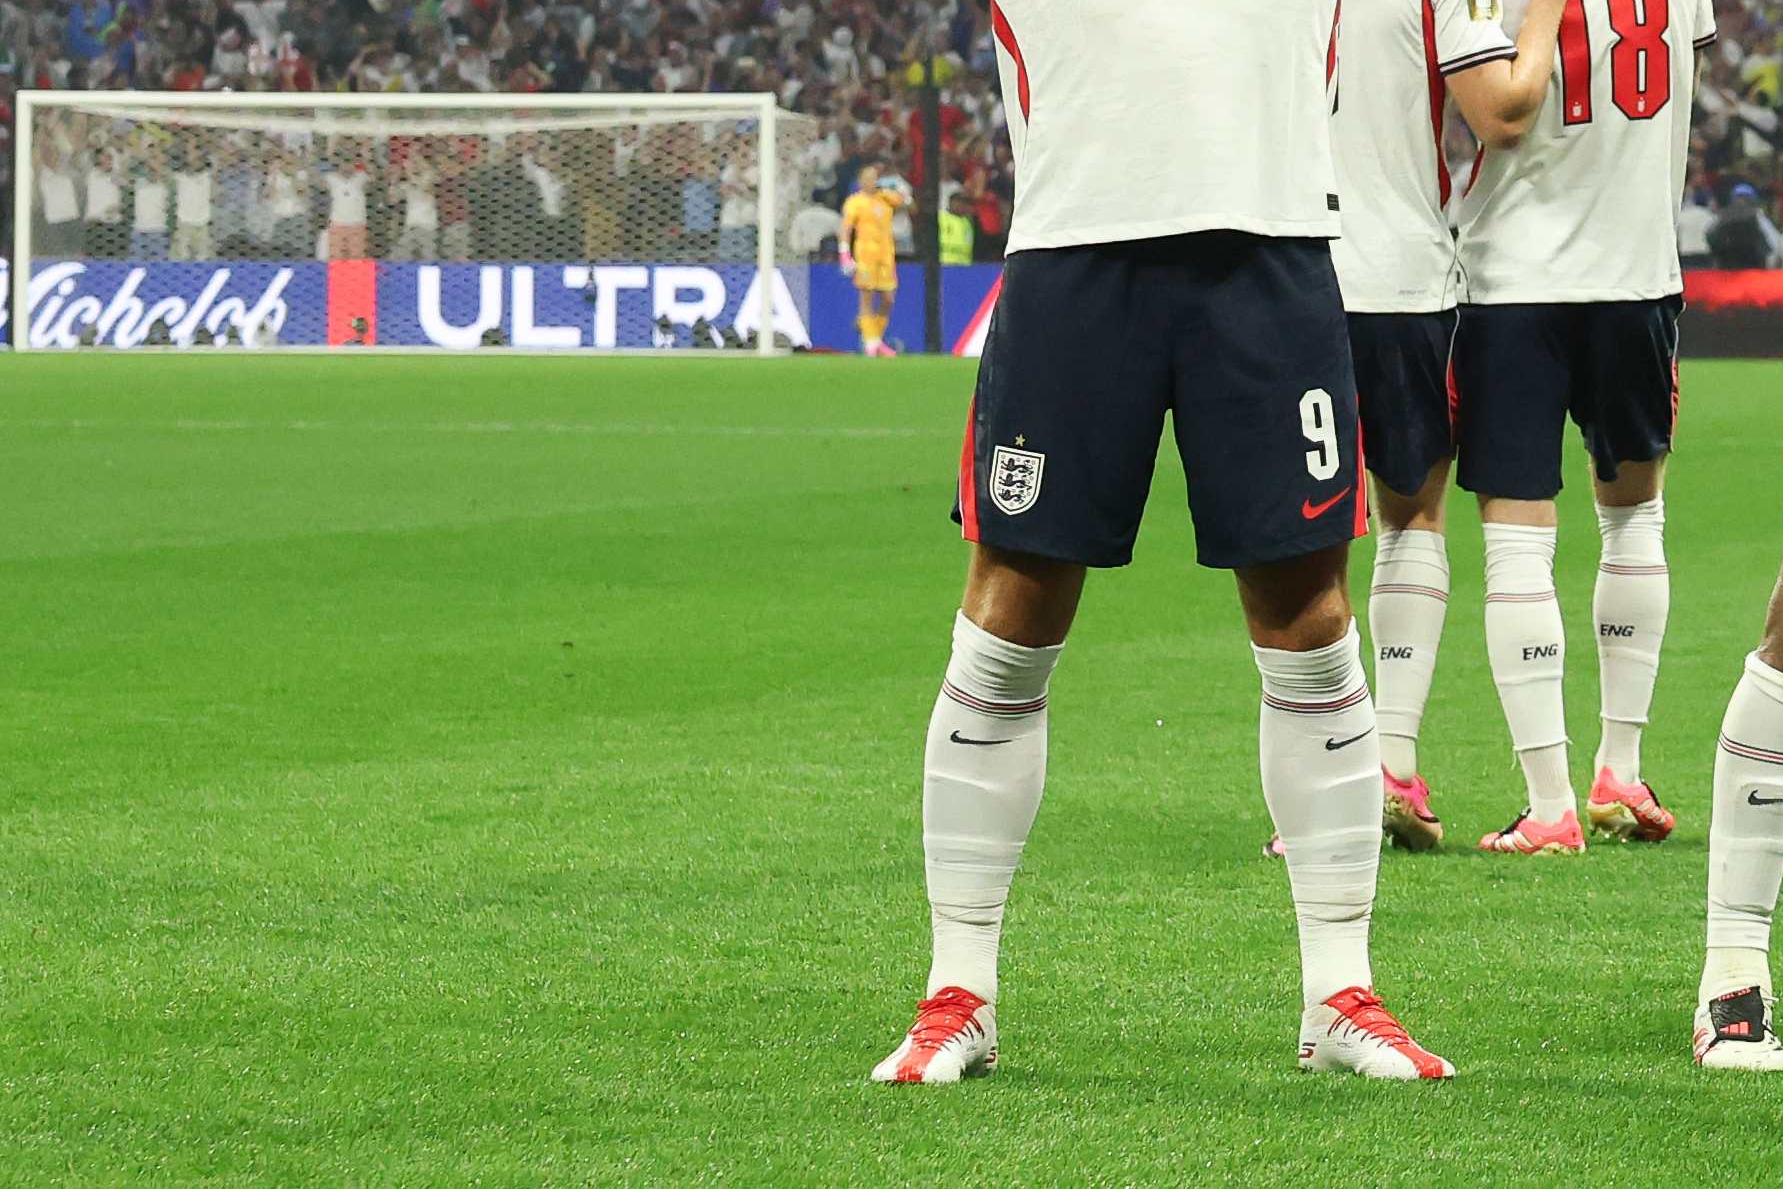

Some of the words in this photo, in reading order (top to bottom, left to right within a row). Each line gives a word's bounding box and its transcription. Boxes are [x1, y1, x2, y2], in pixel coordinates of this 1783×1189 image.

[417, 265, 812, 349] ULTRA
[1299, 388, 1340, 481] 9
[1600, 623, 1635, 637] ENG
[1380, 646, 1414, 660] ENG
[1522, 643, 1558, 661] ENG
